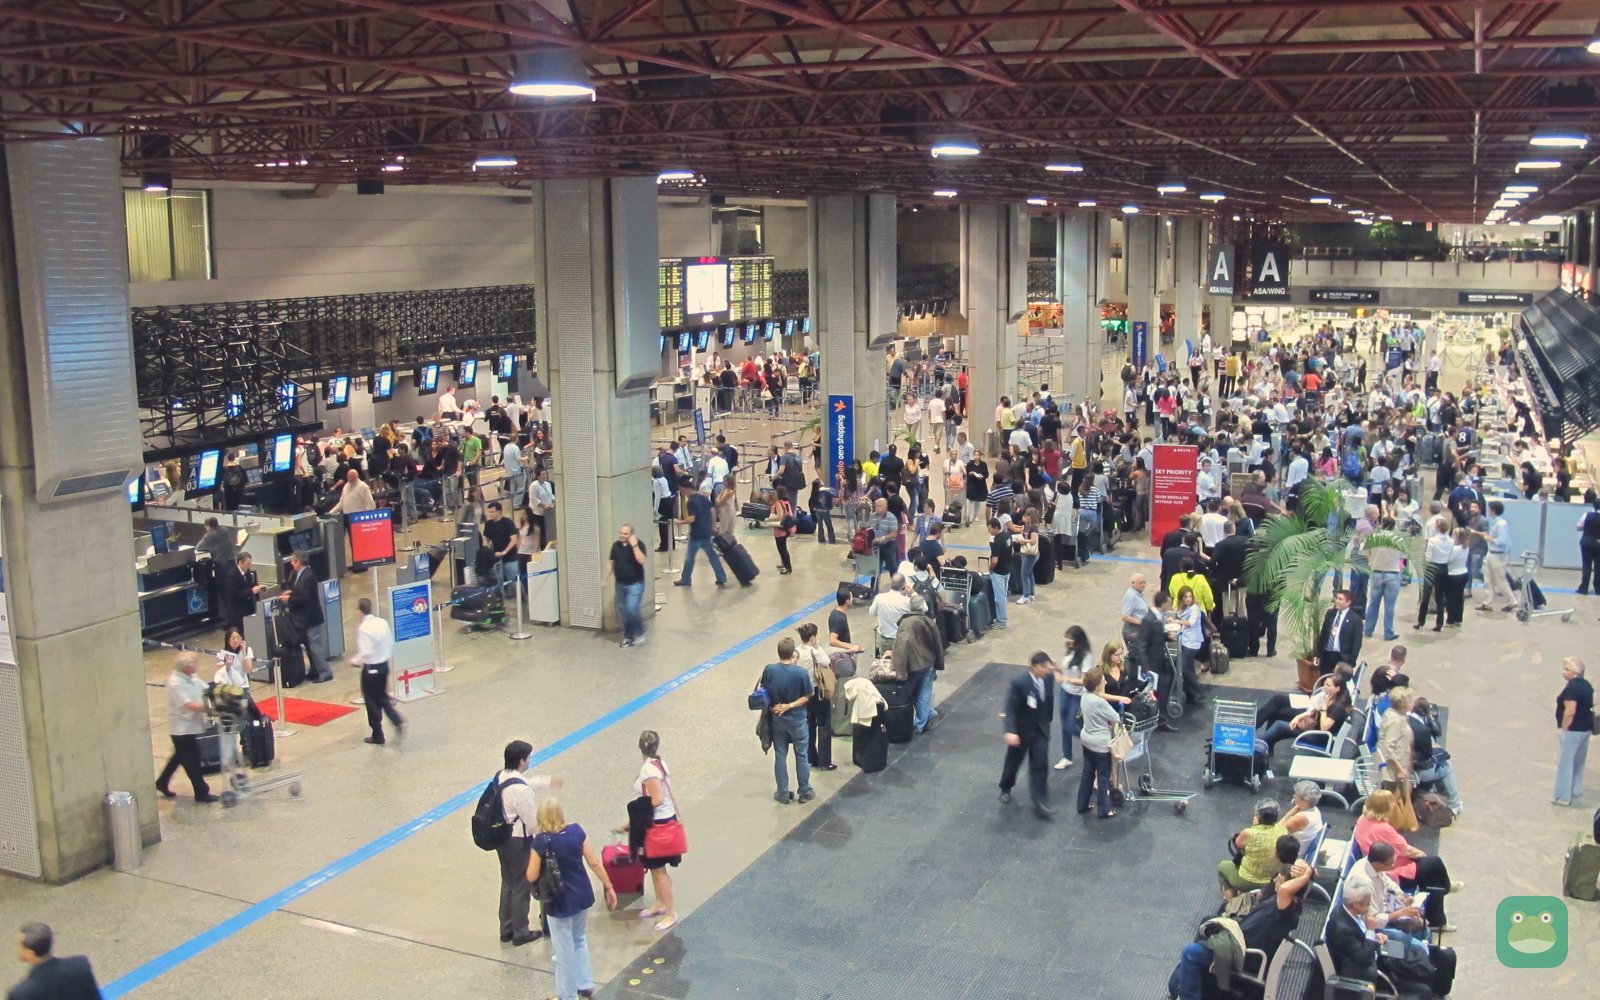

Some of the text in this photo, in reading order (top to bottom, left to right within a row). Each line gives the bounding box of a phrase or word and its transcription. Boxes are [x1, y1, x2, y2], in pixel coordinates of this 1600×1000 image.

[1213, 251, 1229, 280] A
[1259, 252, 1280, 282] A
[1253, 287, 1285, 295] ASA/WING
[837, 414, 846, 445] shopping
[1459, 432, 1467, 442] 8
[190, 467, 197, 479] A
[263, 464, 273, 474] 04
[186, 480, 197, 491] 03
[360, 512, 388, 520] UNITED
